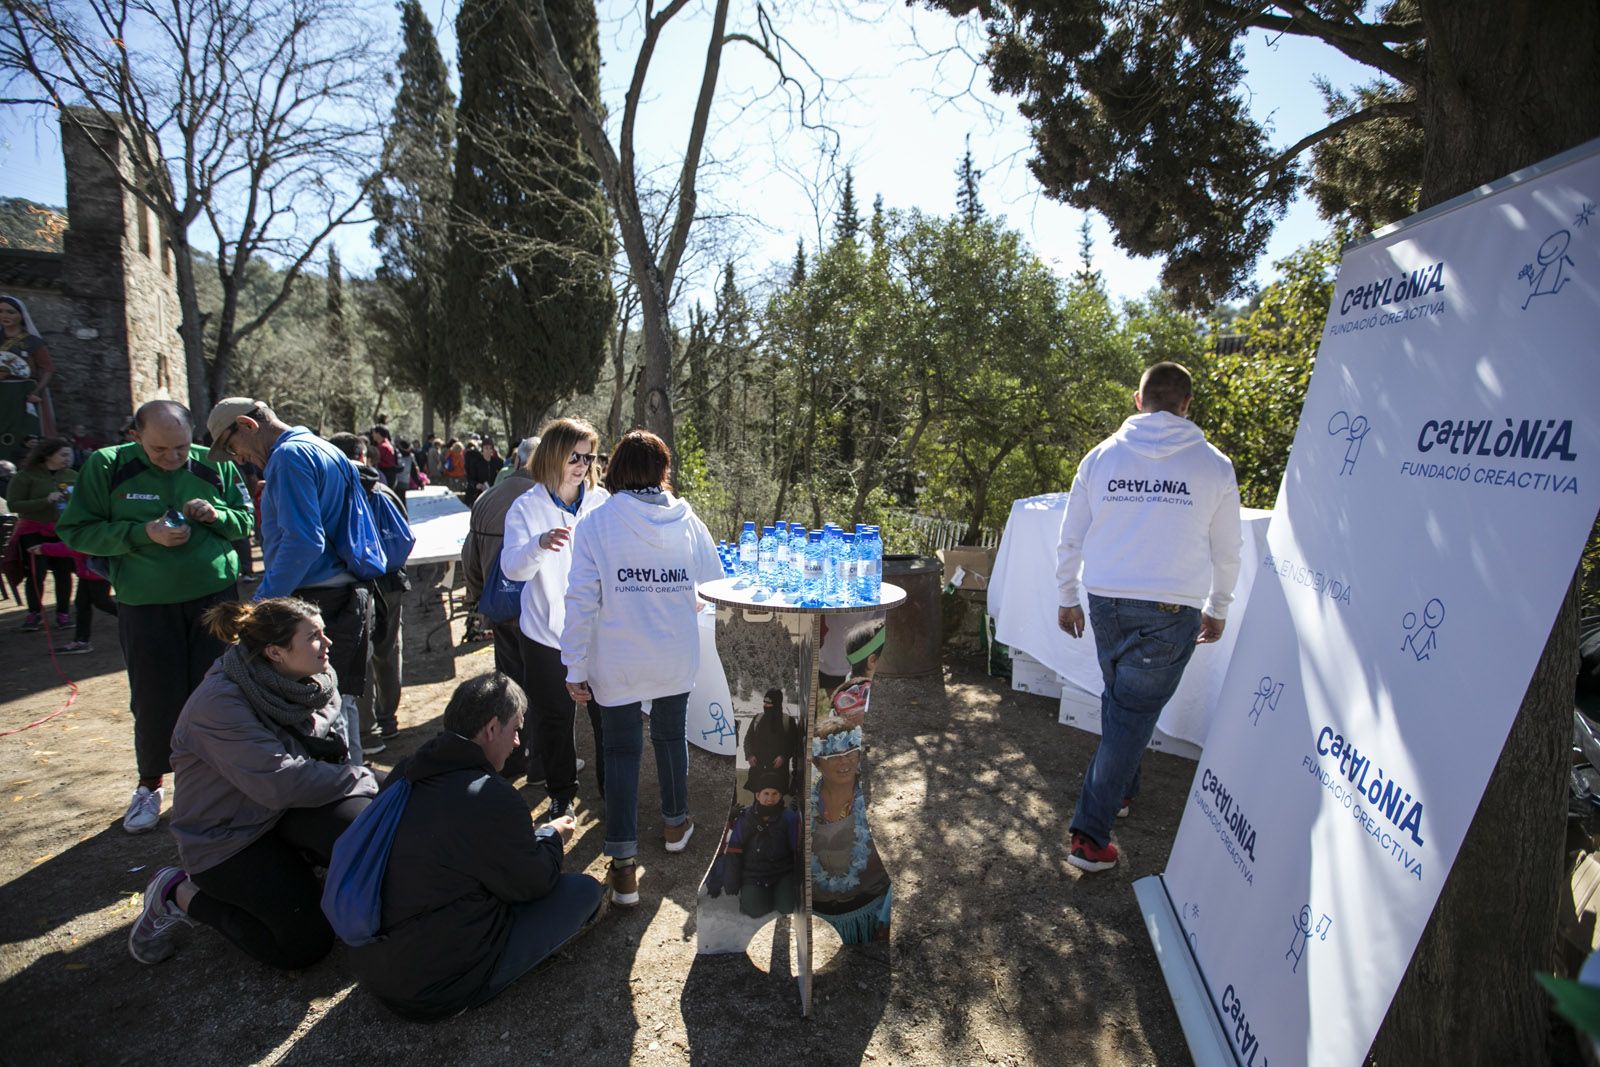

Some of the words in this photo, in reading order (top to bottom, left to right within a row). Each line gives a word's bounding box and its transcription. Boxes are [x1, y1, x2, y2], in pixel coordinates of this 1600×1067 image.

[1328, 314, 1378, 337] FUNDACIÓ
[1379, 301, 1445, 327] CREACTIVA
[1400, 461, 1471, 482] FUNDACIÓ
[1473, 467, 1578, 495] CREACTIVA
[1102, 495, 1145, 503] FUNDACIÓ
[1146, 496, 1194, 507] CREACTIVA
[615, 585, 654, 593] FUNDACIÓ
[655, 585, 693, 594] CREACTIVA
[1302, 755, 1353, 809] FUNDACIÓ
[1353, 804, 1423, 881] CREACTIVA
[1193, 790, 1222, 833] FUNDACIÓ
[1221, 830, 1253, 887] CREACTIVA
